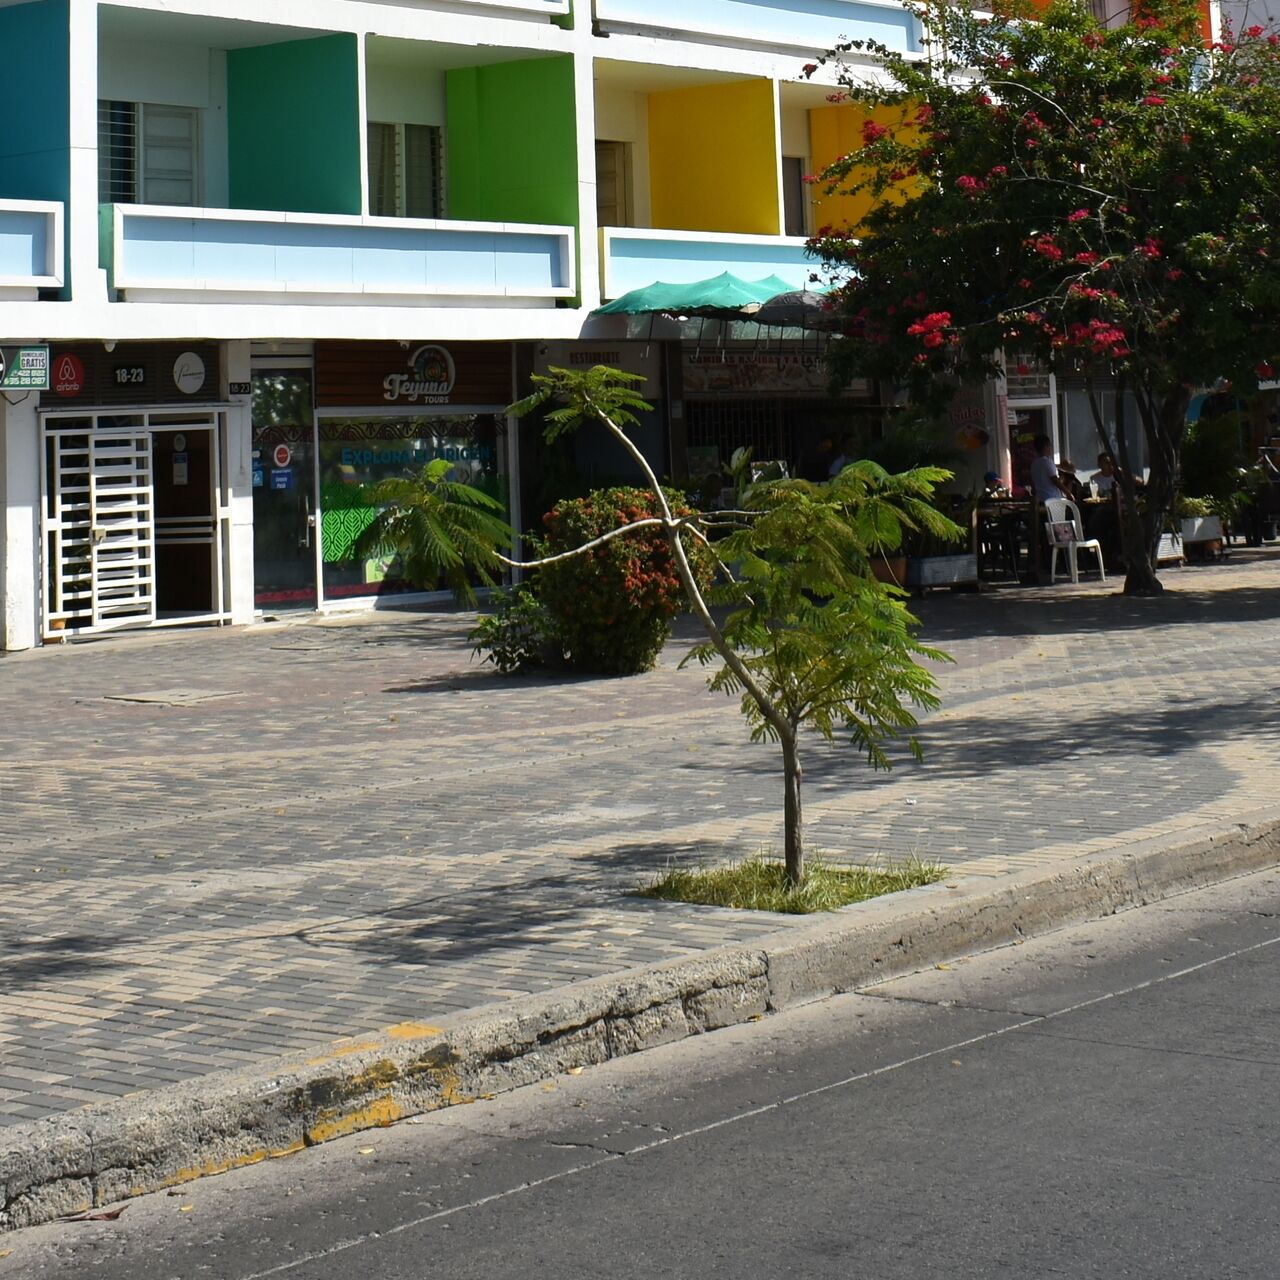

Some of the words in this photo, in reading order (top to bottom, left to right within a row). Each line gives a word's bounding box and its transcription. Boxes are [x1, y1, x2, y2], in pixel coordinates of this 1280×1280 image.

[21, 358, 45, 367] GRATIS
[115, 368, 144, 383] 18-23
[56, 382, 79, 391] airbnb
[383, 373, 450, 401] Teyuna
[425, 395, 449, 404] TOURS
